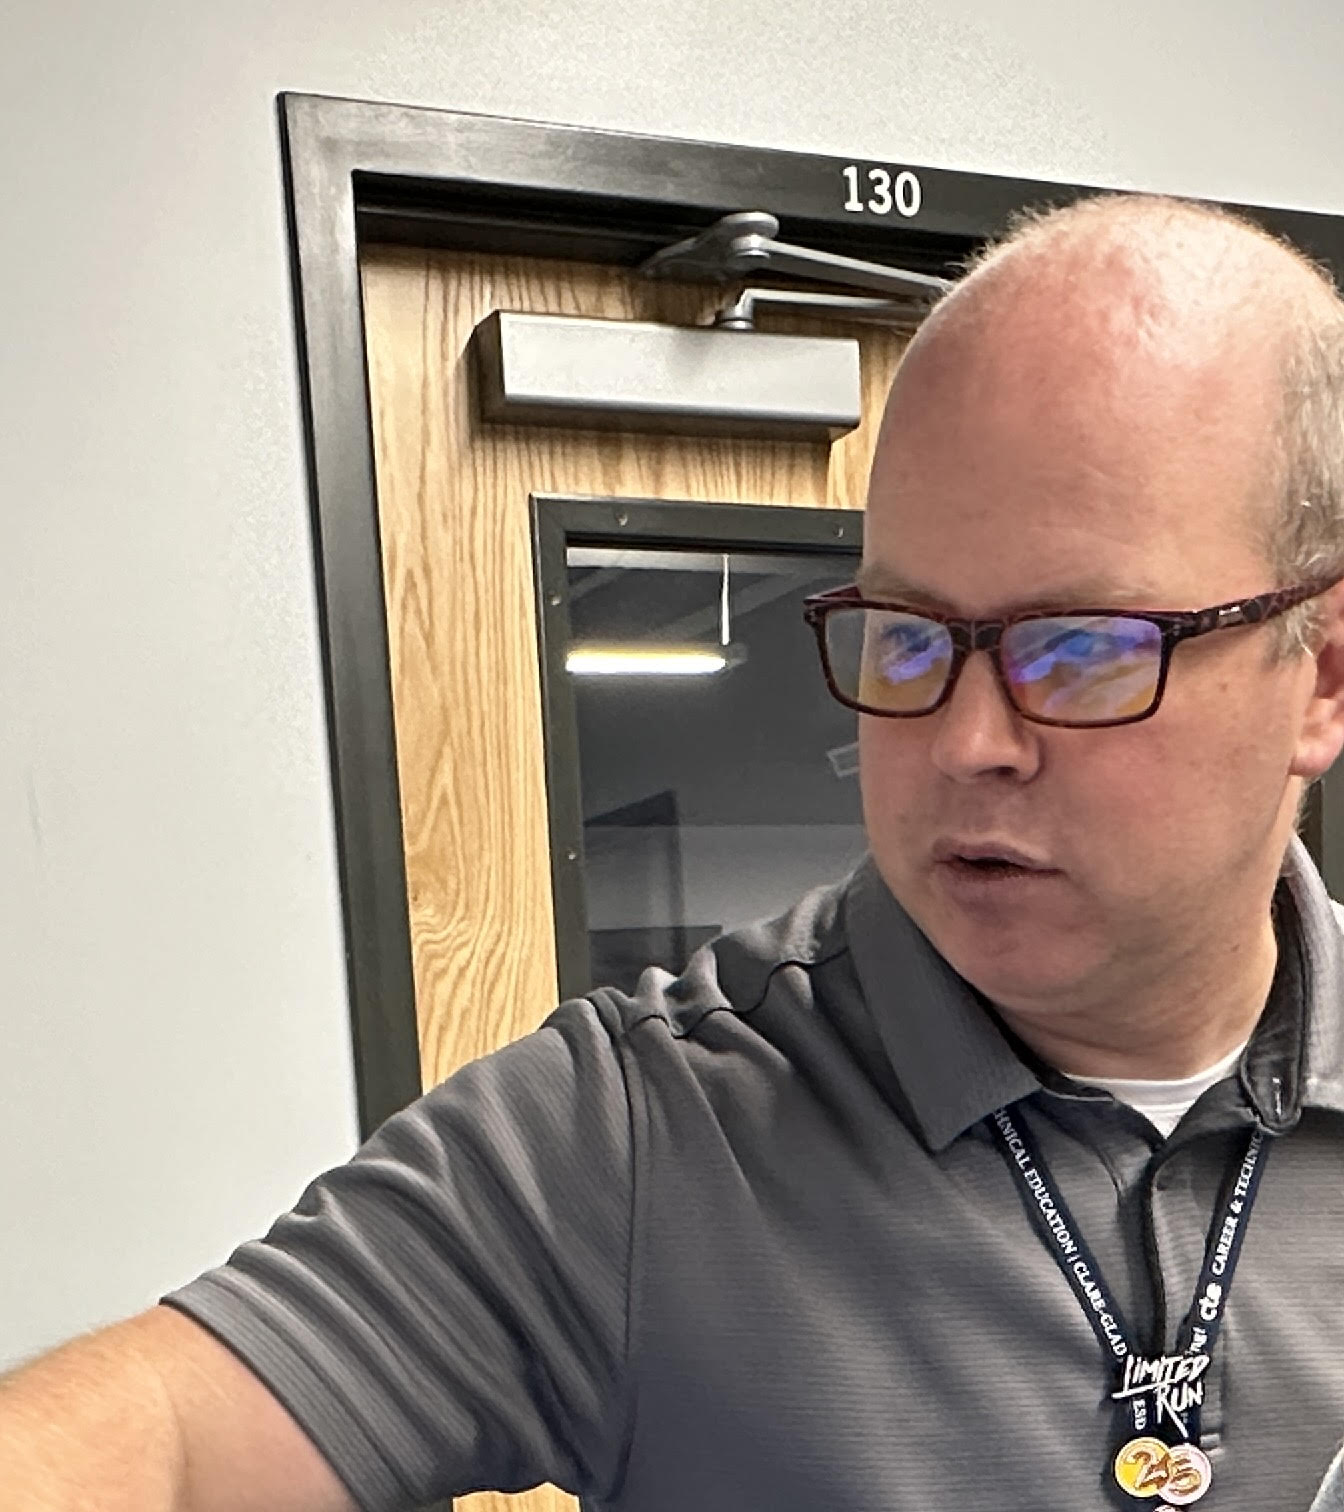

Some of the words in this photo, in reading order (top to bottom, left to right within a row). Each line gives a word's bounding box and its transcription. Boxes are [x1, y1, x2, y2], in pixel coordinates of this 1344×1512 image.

[842, 165, 922, 217] 130
[1024, 1168, 1078, 1254] EDUCATION
[1212, 1216, 1239, 1276] CAREER
[1112, 1353, 1210, 1399] LIMITED
[1155, 1380, 1205, 1438] RUN
